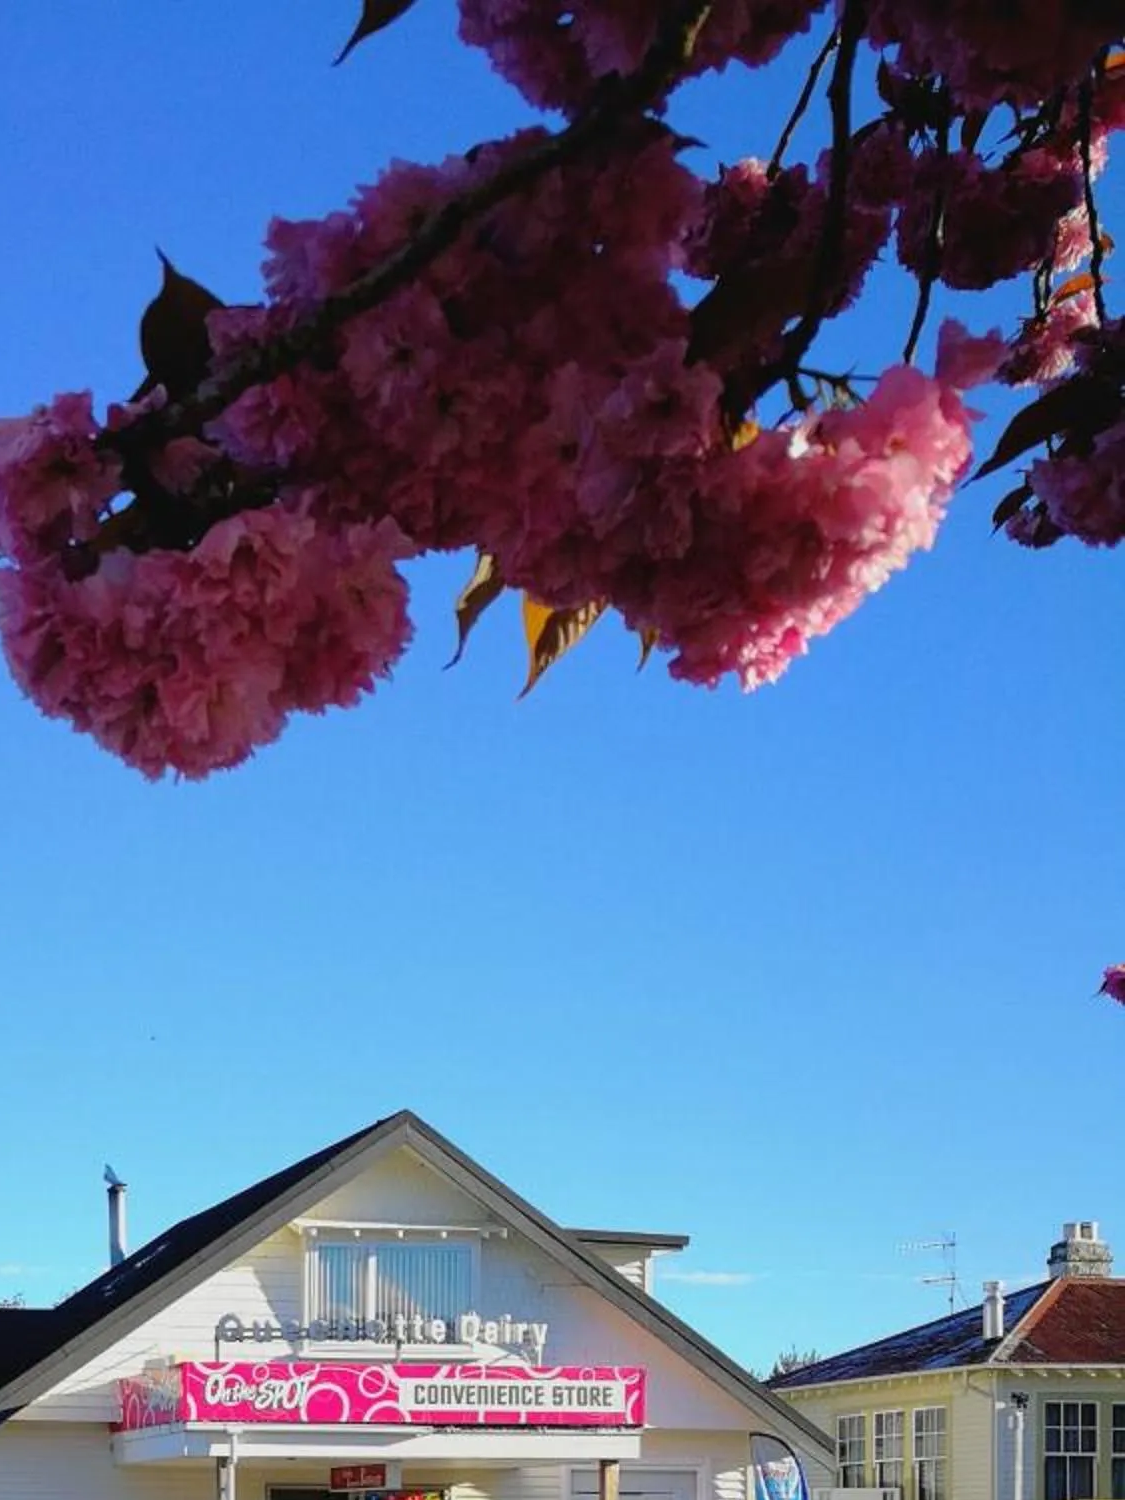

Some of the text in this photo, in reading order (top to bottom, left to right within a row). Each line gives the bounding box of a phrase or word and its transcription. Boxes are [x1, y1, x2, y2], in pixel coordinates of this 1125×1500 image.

[460, 1310, 549, 1344] Dairy
[254, 1372, 317, 1410] SPOT
[414, 1383, 613, 1408] CONVENIENCE STORE
